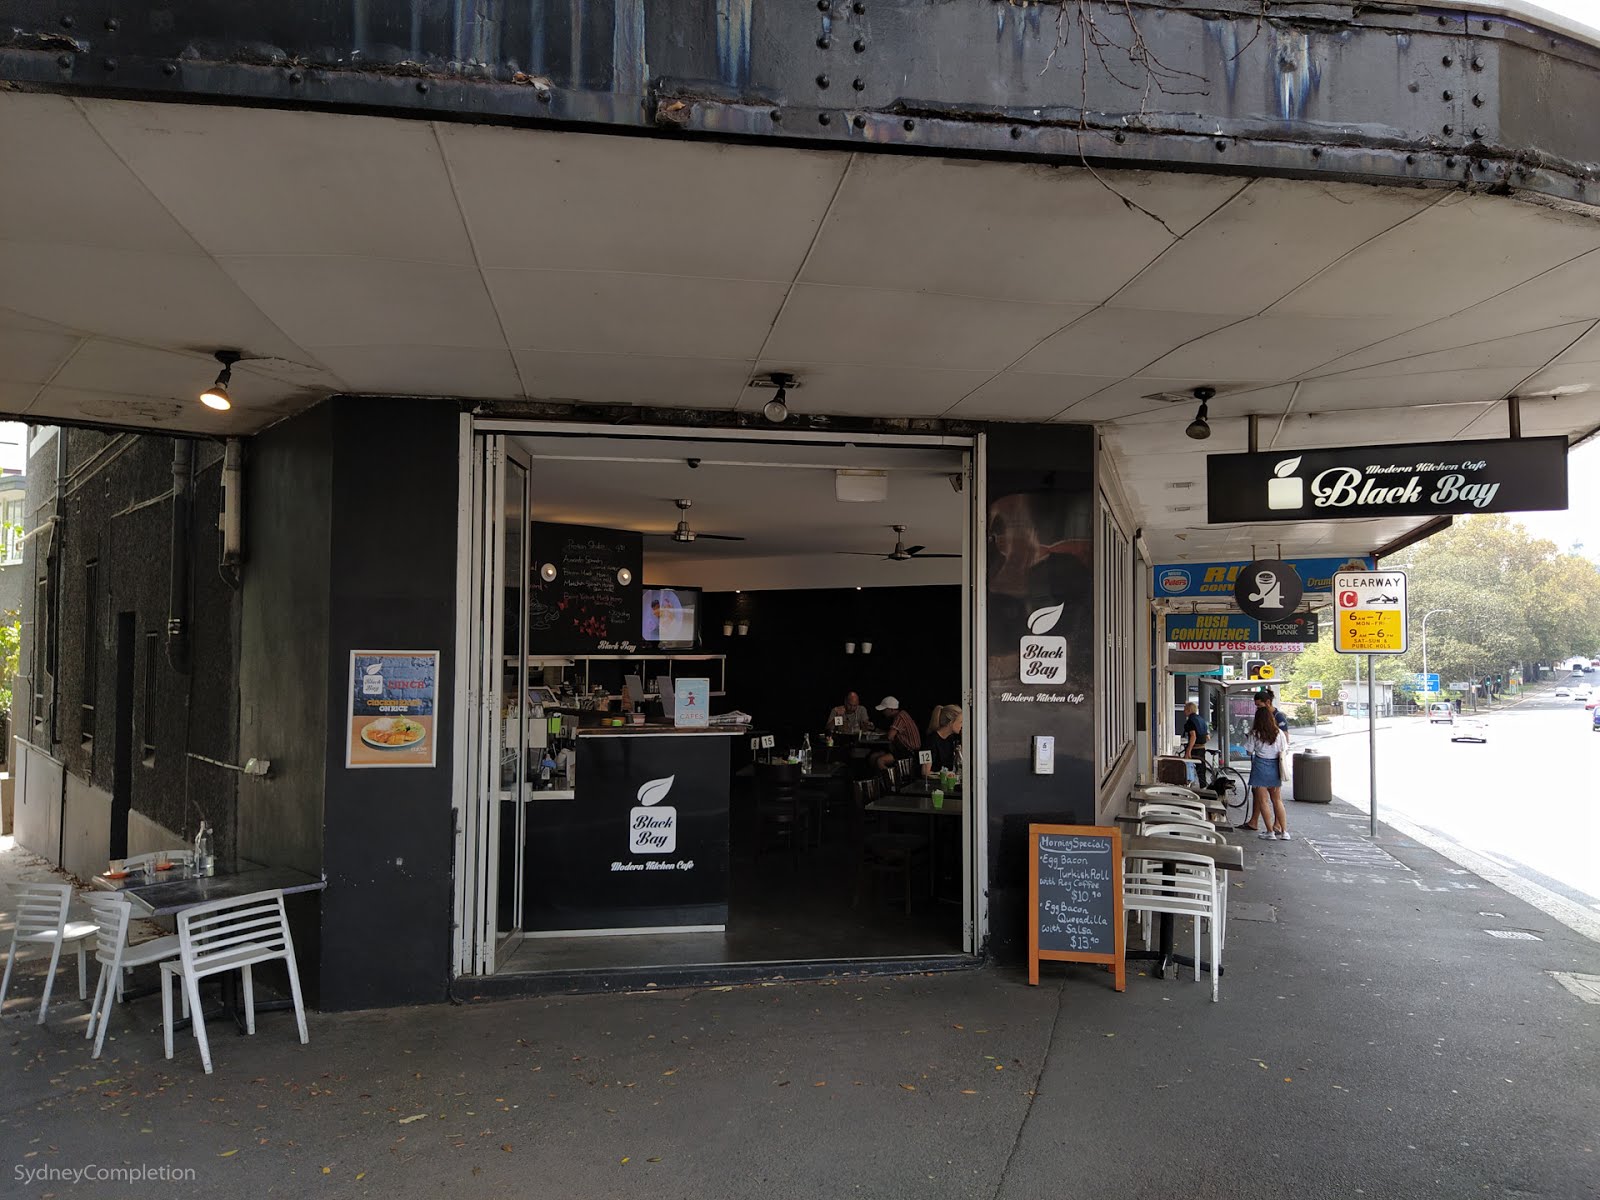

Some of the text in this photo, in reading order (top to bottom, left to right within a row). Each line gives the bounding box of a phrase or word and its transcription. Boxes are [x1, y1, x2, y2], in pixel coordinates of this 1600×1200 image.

[1365, 465, 1412, 475] Modern
[1416, 462, 1458, 472] Kitchen
[1311, 467, 1500, 508] Black Bay
[1338, 578, 1400, 588] CLEARWAY
[1342, 591, 1355, 607] C
[1196, 615, 1229, 628] RUSH
[1307, 620, 1315, 635] ATM
[1171, 627, 1250, 641] CONVENIENCE
[1023, 643, 1064, 660] Black
[1179, 641, 1214, 650] MOJO
[1218, 641, 1246, 650] Pets
[1026, 660, 1059, 680] Bay
[1001, 692, 1034, 702] Modern
[1036, 692, 1066, 703] Kitchen
[921, 752, 930, 762] 12
[632, 814, 674, 831] Black
[635, 830, 669, 849] Bay
[610, 862, 645, 872] Modern
[645, 861, 676, 871] Kitchen
[1042, 854, 1088, 870] Egg Bacon
[1057, 867, 1110, 881] Turkish Roll
[1073, 880, 1100, 890] Coffee
[1044, 900, 1089, 915] Egg Bacon
[1057, 912, 1108, 926] Quesadilla
[1041, 923, 1093, 935] with Salsa
